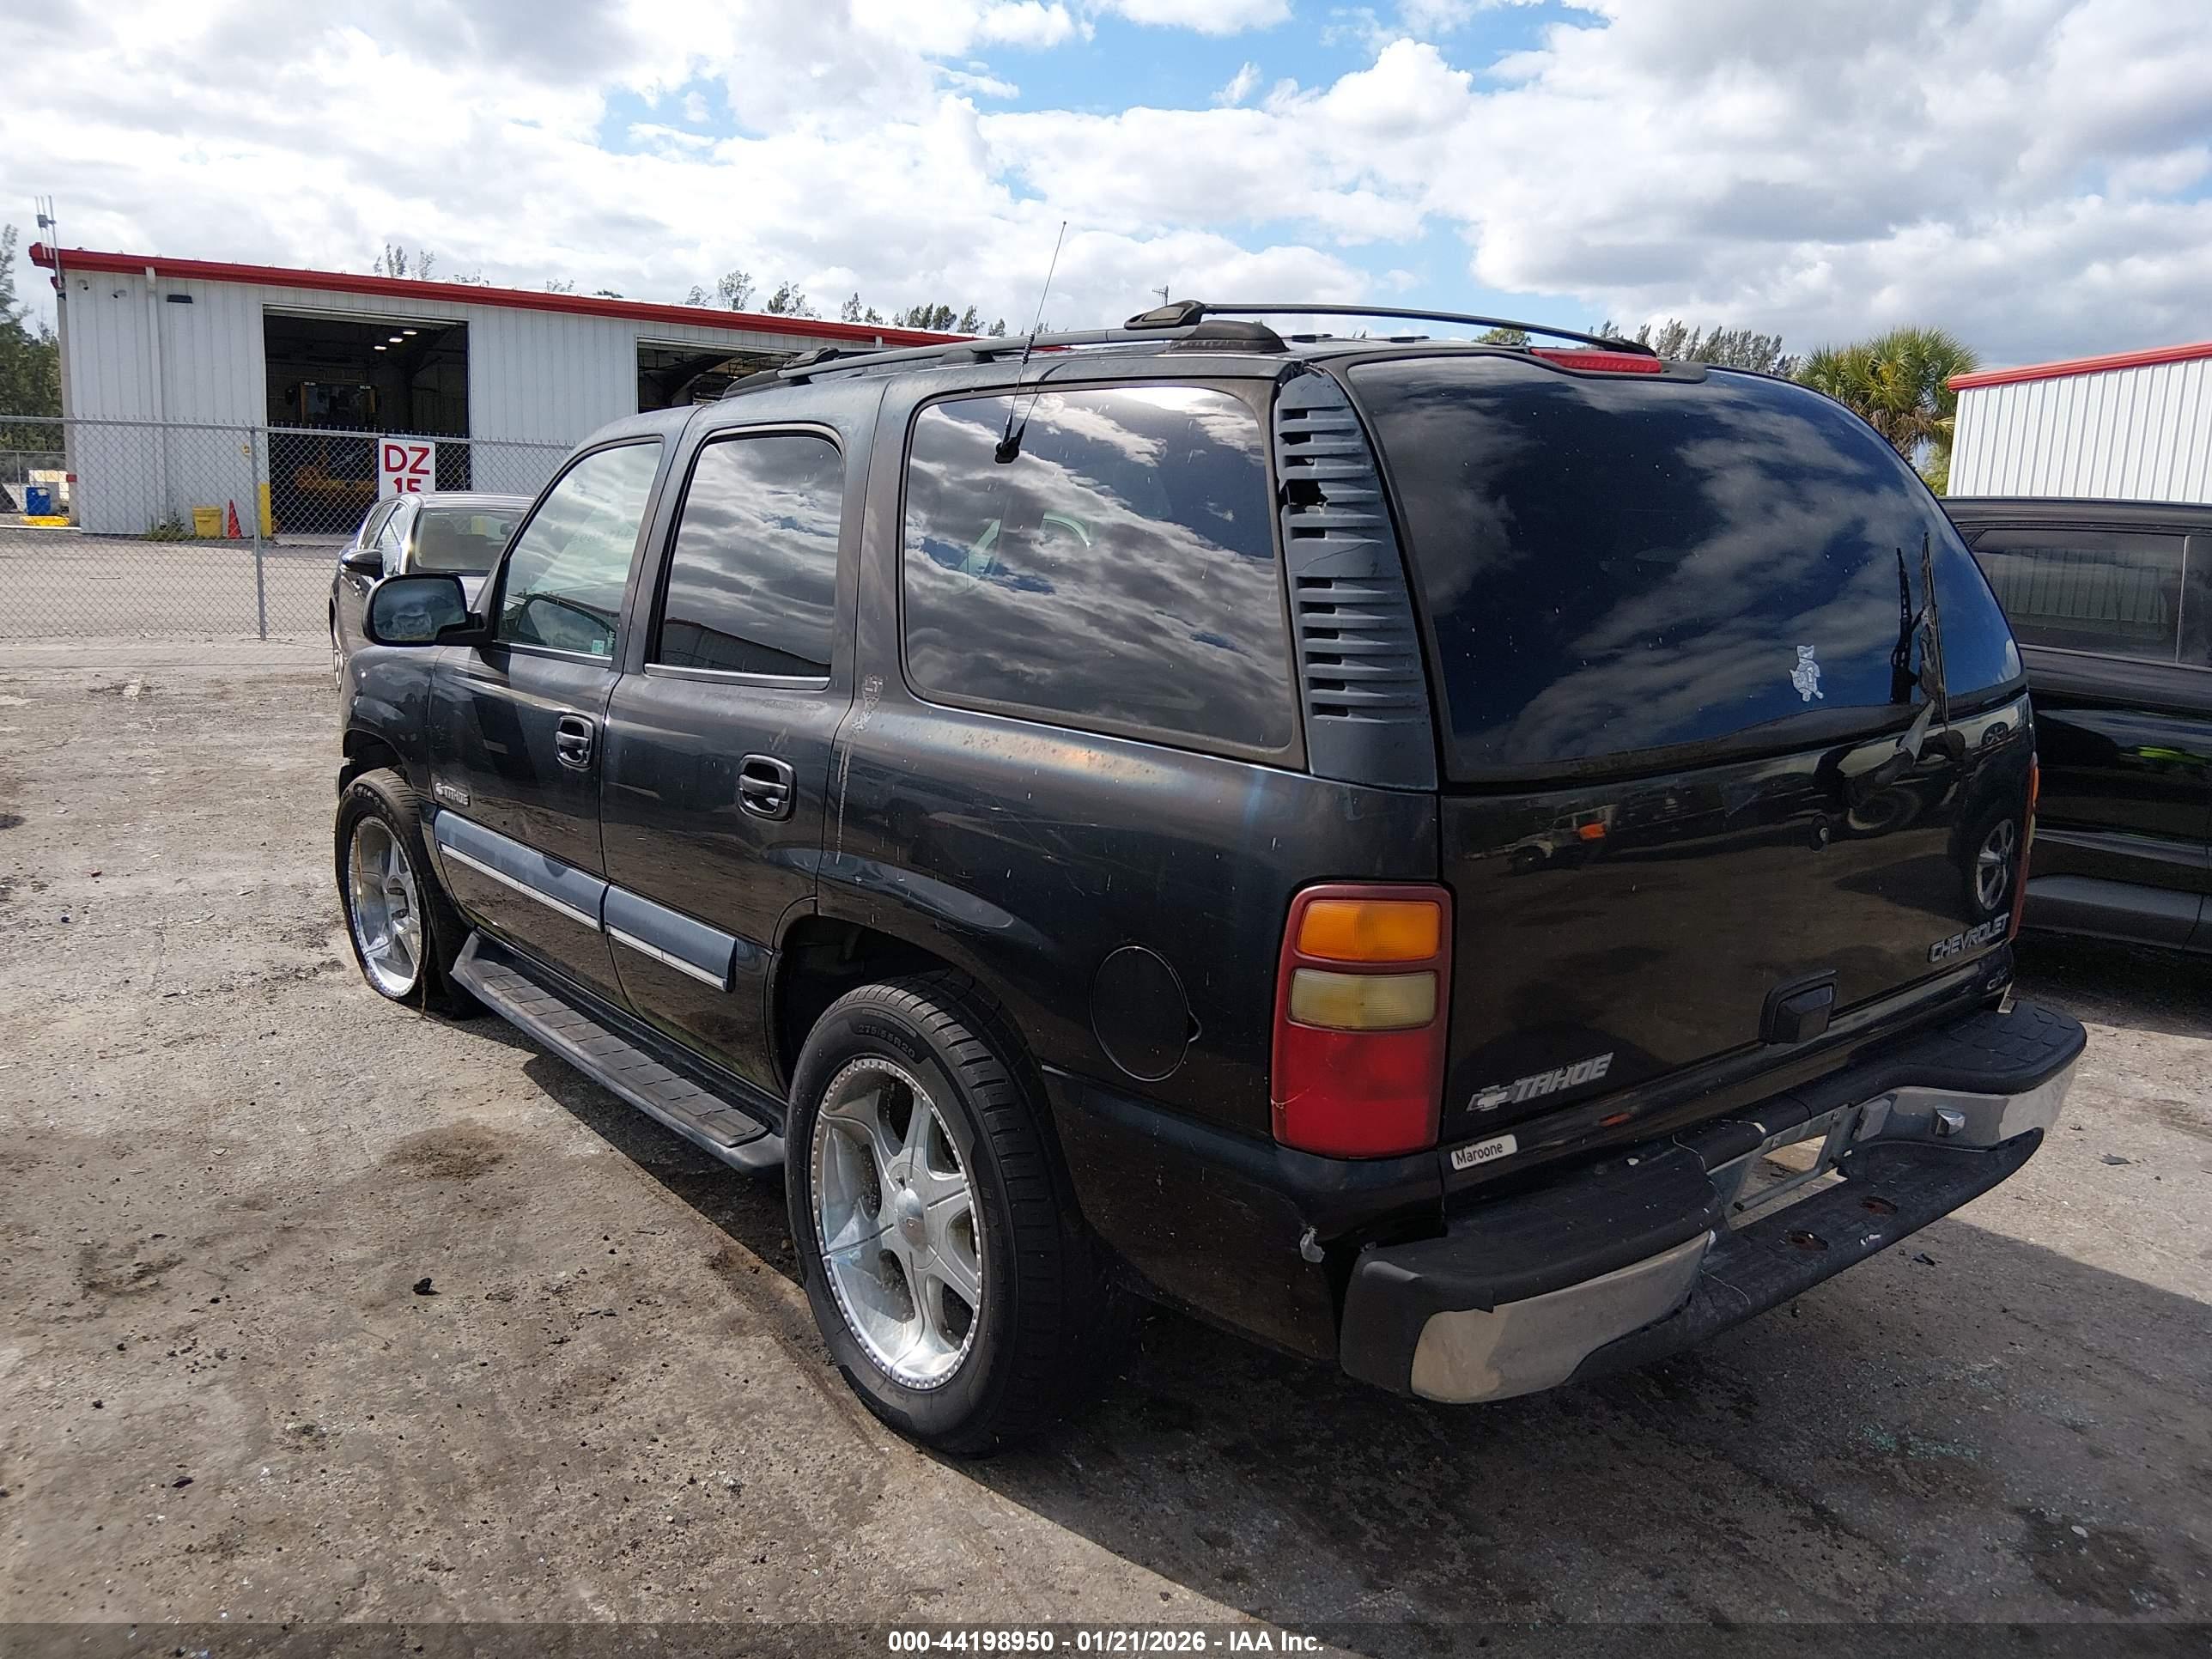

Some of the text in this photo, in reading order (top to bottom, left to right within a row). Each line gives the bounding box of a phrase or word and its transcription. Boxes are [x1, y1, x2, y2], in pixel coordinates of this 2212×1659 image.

[384, 444, 430, 475] DZ
[1929, 911, 2009, 962] CHEVROLET
[1511, 1051, 1614, 1104] TAHOE
[1455, 1140, 1504, 1165] Maroone
